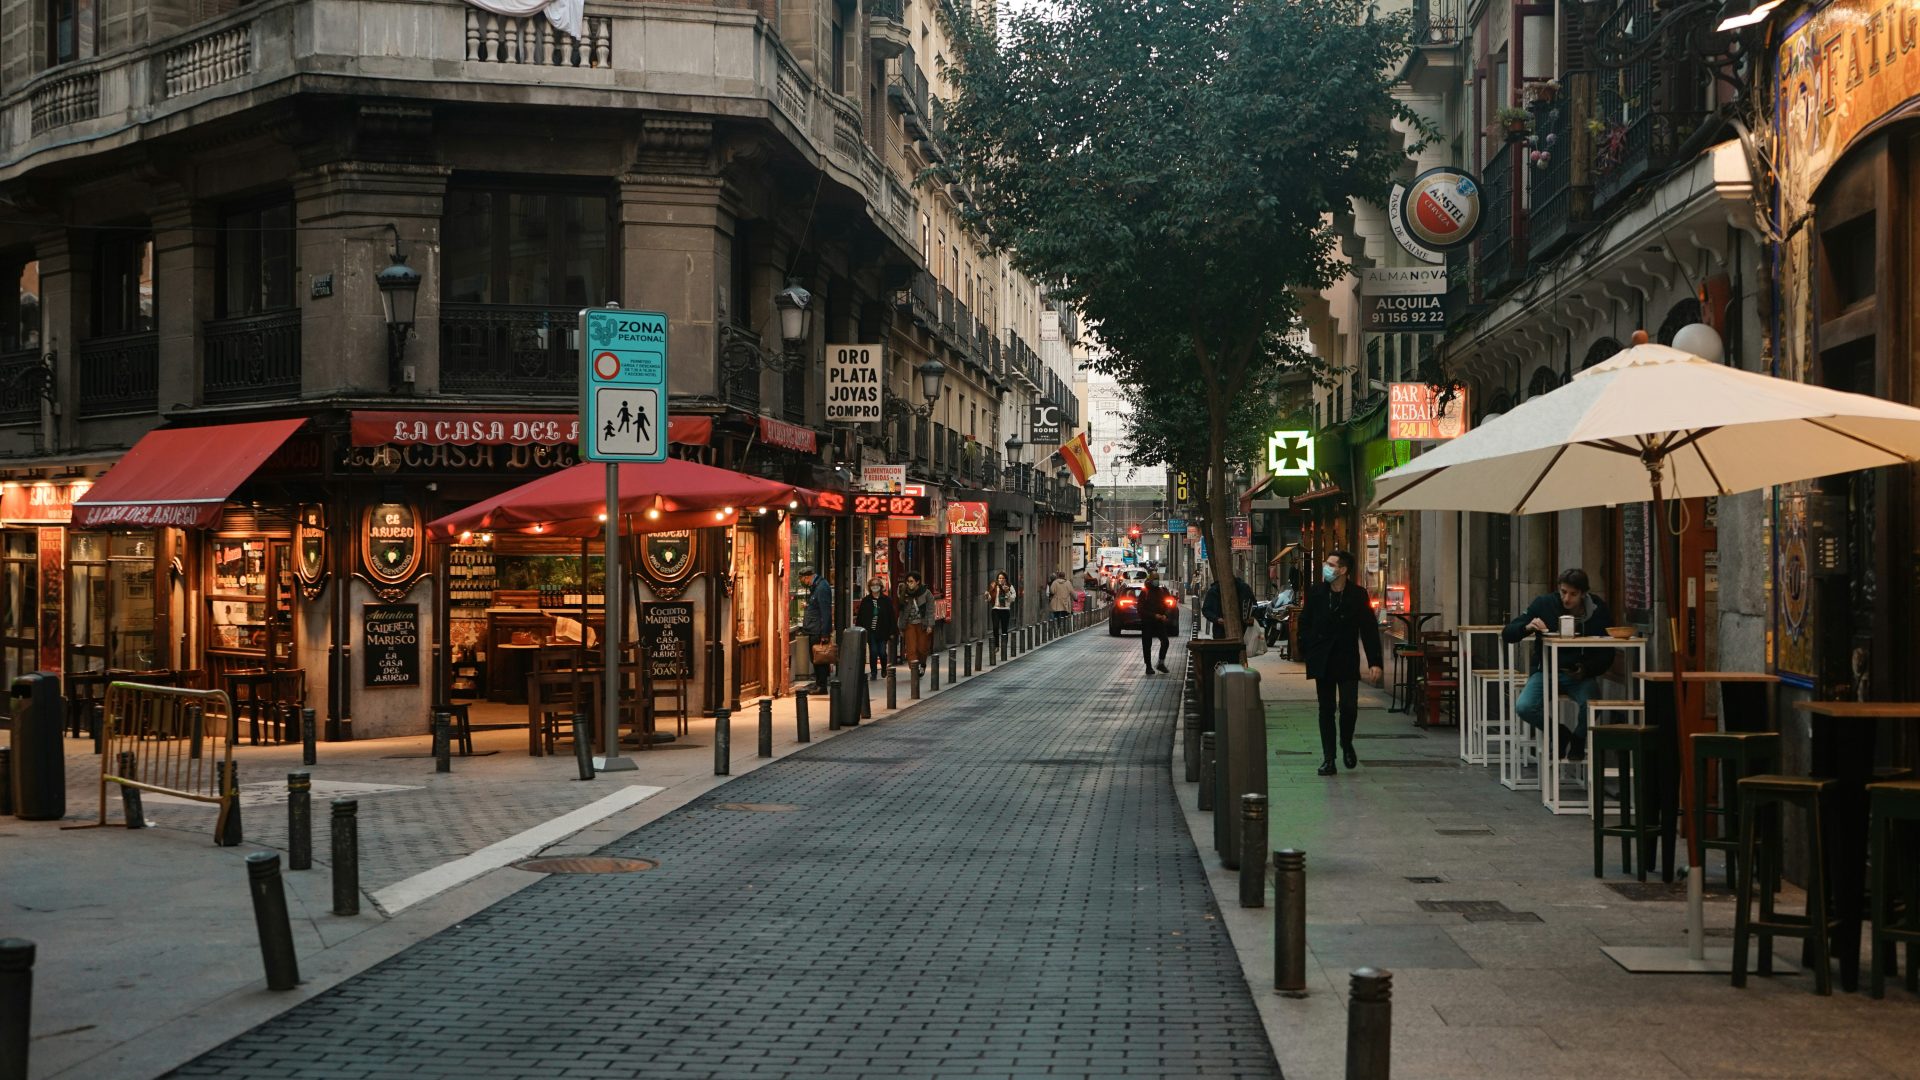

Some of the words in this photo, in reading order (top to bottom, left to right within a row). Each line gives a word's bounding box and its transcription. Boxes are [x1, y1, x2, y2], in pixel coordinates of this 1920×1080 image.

[1391, 193, 1400, 220] TASCA
[1424, 199, 1450, 227] CERVEZA
[1430, 188, 1464, 223] AMSTEL
[1394, 226, 1404, 238] DE
[1404, 240, 1429, 259] JAIME
[1369, 270, 1447, 281] ALMANOVA
[1376, 297, 1440, 310] ALQUILA
[1372, 312, 1384, 323] 91
[1388, 312, 1408, 323] 156
[1411, 312, 1427, 322] 92
[1429, 311, 1444, 322] 22
[618, 321, 664, 334] ZONA
[618, 334, 664, 342] PEATONAL
[838, 349, 869, 364] ORO
[830, 368, 877, 383] PLATA
[829, 386, 877, 401] JOYAS
[1392, 385, 1419, 402] BAR
[827, 405, 879, 417] COMPRO
[1033, 406, 1058, 426] JC
[1391, 403, 1438, 420] KEBAB
[394, 421, 428, 441] LA
[434, 420, 504, 441] CASA
[510, 421, 561, 441] DEL
[1400, 422, 1416, 437] 24
[1419, 422, 1428, 437] H
[403, 446, 495, 468] CASA
[506, 447, 575, 468] DEL
[863, 467, 902, 475] ALIMENTACION
[855, 497, 914, 514] 22:02
[125, 506, 149, 522] DEL
[148, 506, 198, 525] ABUELO
[386, 514, 400, 525] EL
[370, 527, 414, 538] ABUELO
[371, 554, 383, 570] VINO
[382, 554, 412, 575] GENEROSO
[649, 554, 660, 569] VINO
[660, 554, 688, 574] GENEROSO
[366, 621, 415, 633] CALDERETA
[367, 634, 416, 645] MARISCO
[379, 659, 403, 667] CASA
[374, 673, 409, 681] ABUELO
